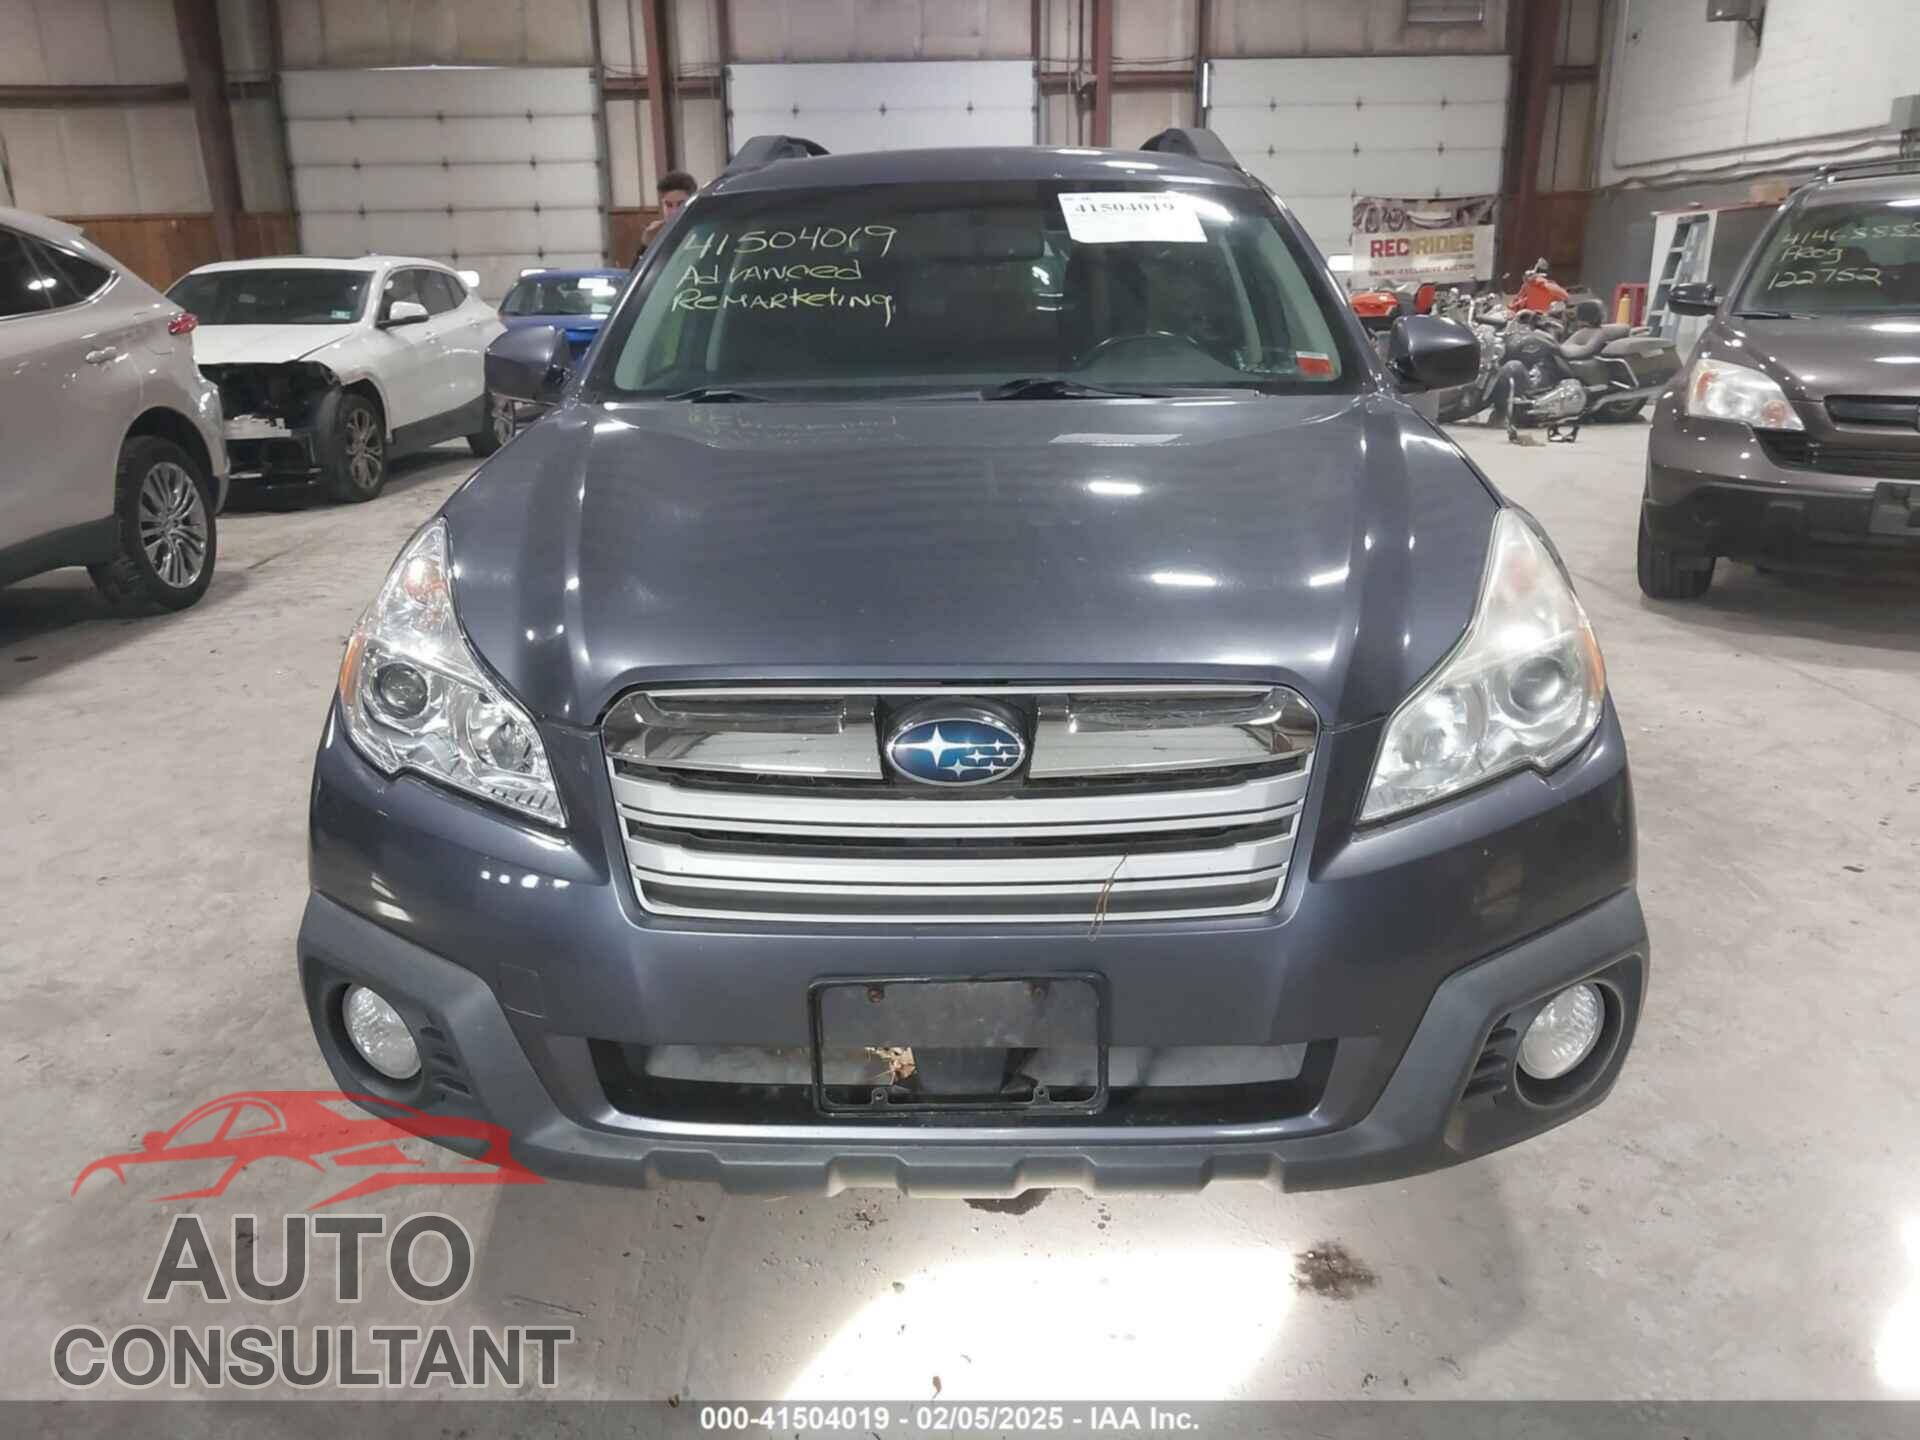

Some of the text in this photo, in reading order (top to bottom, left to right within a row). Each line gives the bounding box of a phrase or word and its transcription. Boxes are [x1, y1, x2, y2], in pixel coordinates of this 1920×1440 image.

[1075, 203, 1175, 213] 41504019
[682, 225, 898, 259] 41504019
[1767, 267, 1883, 290] 122752
